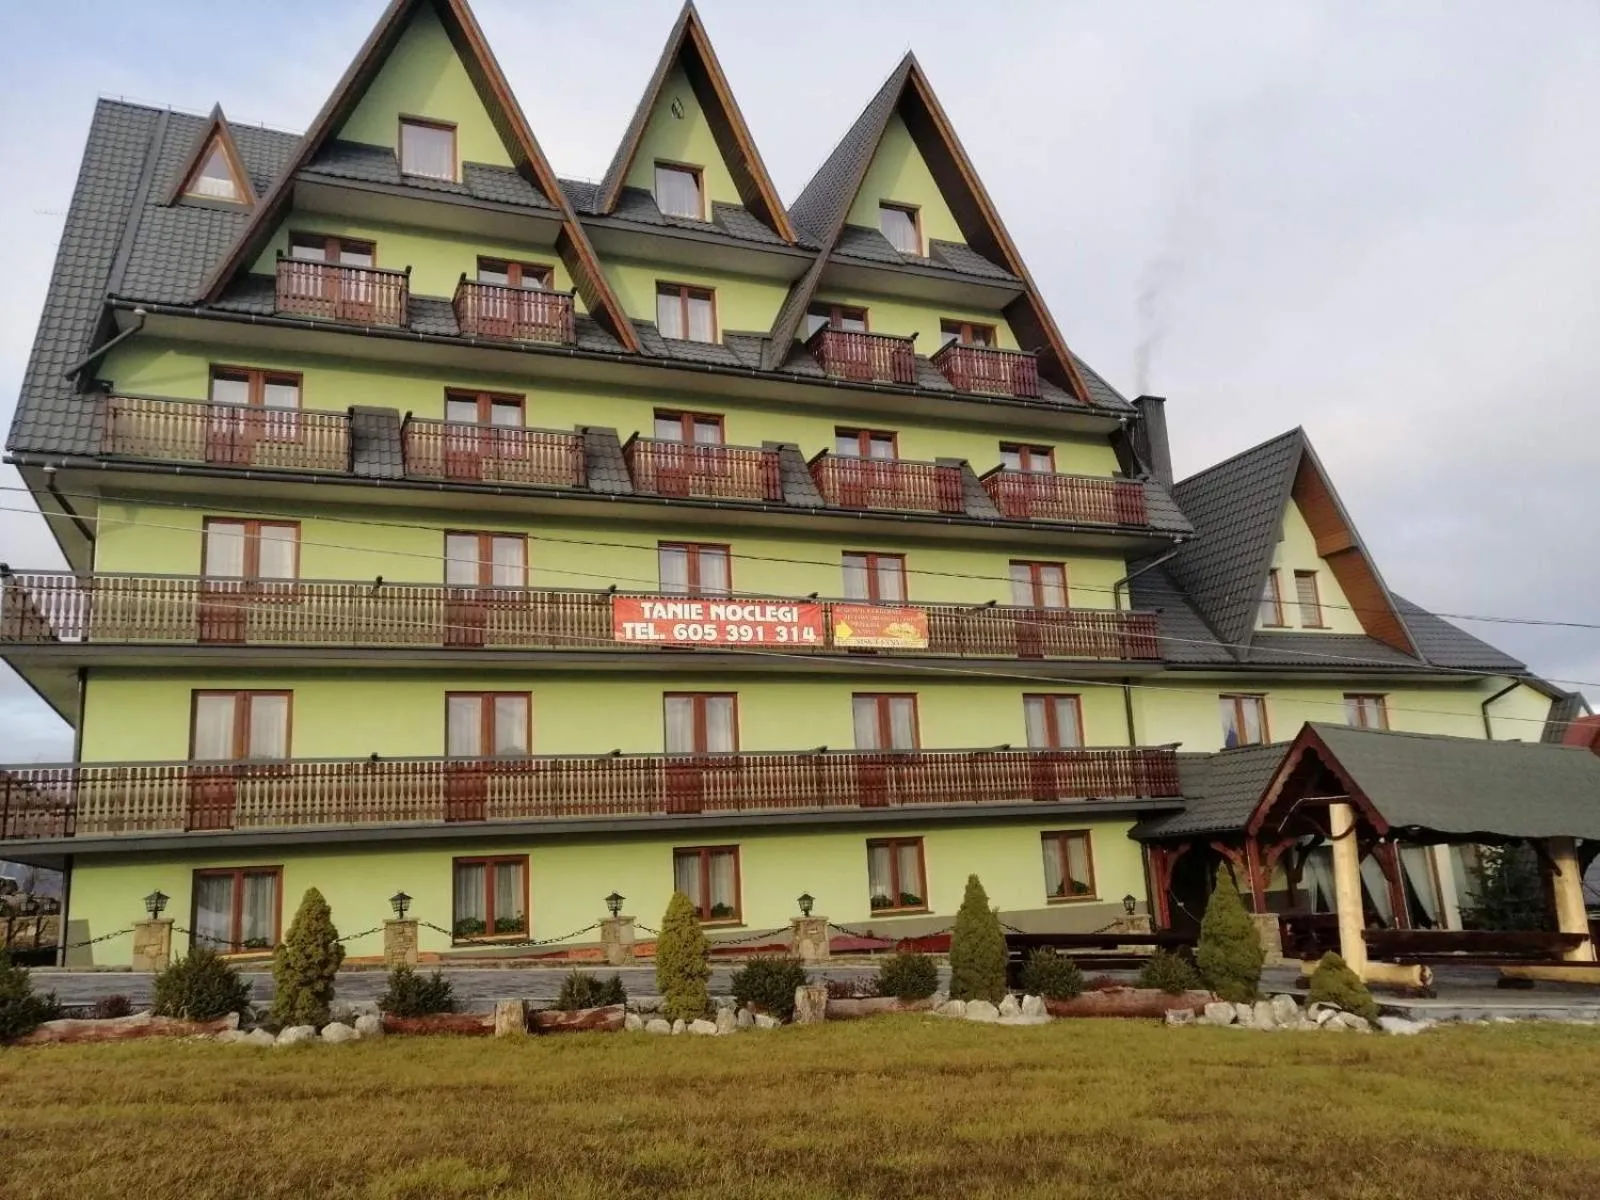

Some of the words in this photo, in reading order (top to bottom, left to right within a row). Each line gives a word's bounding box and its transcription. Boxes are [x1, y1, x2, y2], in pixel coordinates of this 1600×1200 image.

[641, 602, 703, 620] TANIE
[709, 604, 798, 623] NOCLEGI
[623, 622, 665, 640] TEL.
[673, 623, 718, 641] 605
[726, 624, 764, 642] 391
[776, 625, 816, 643] 314
